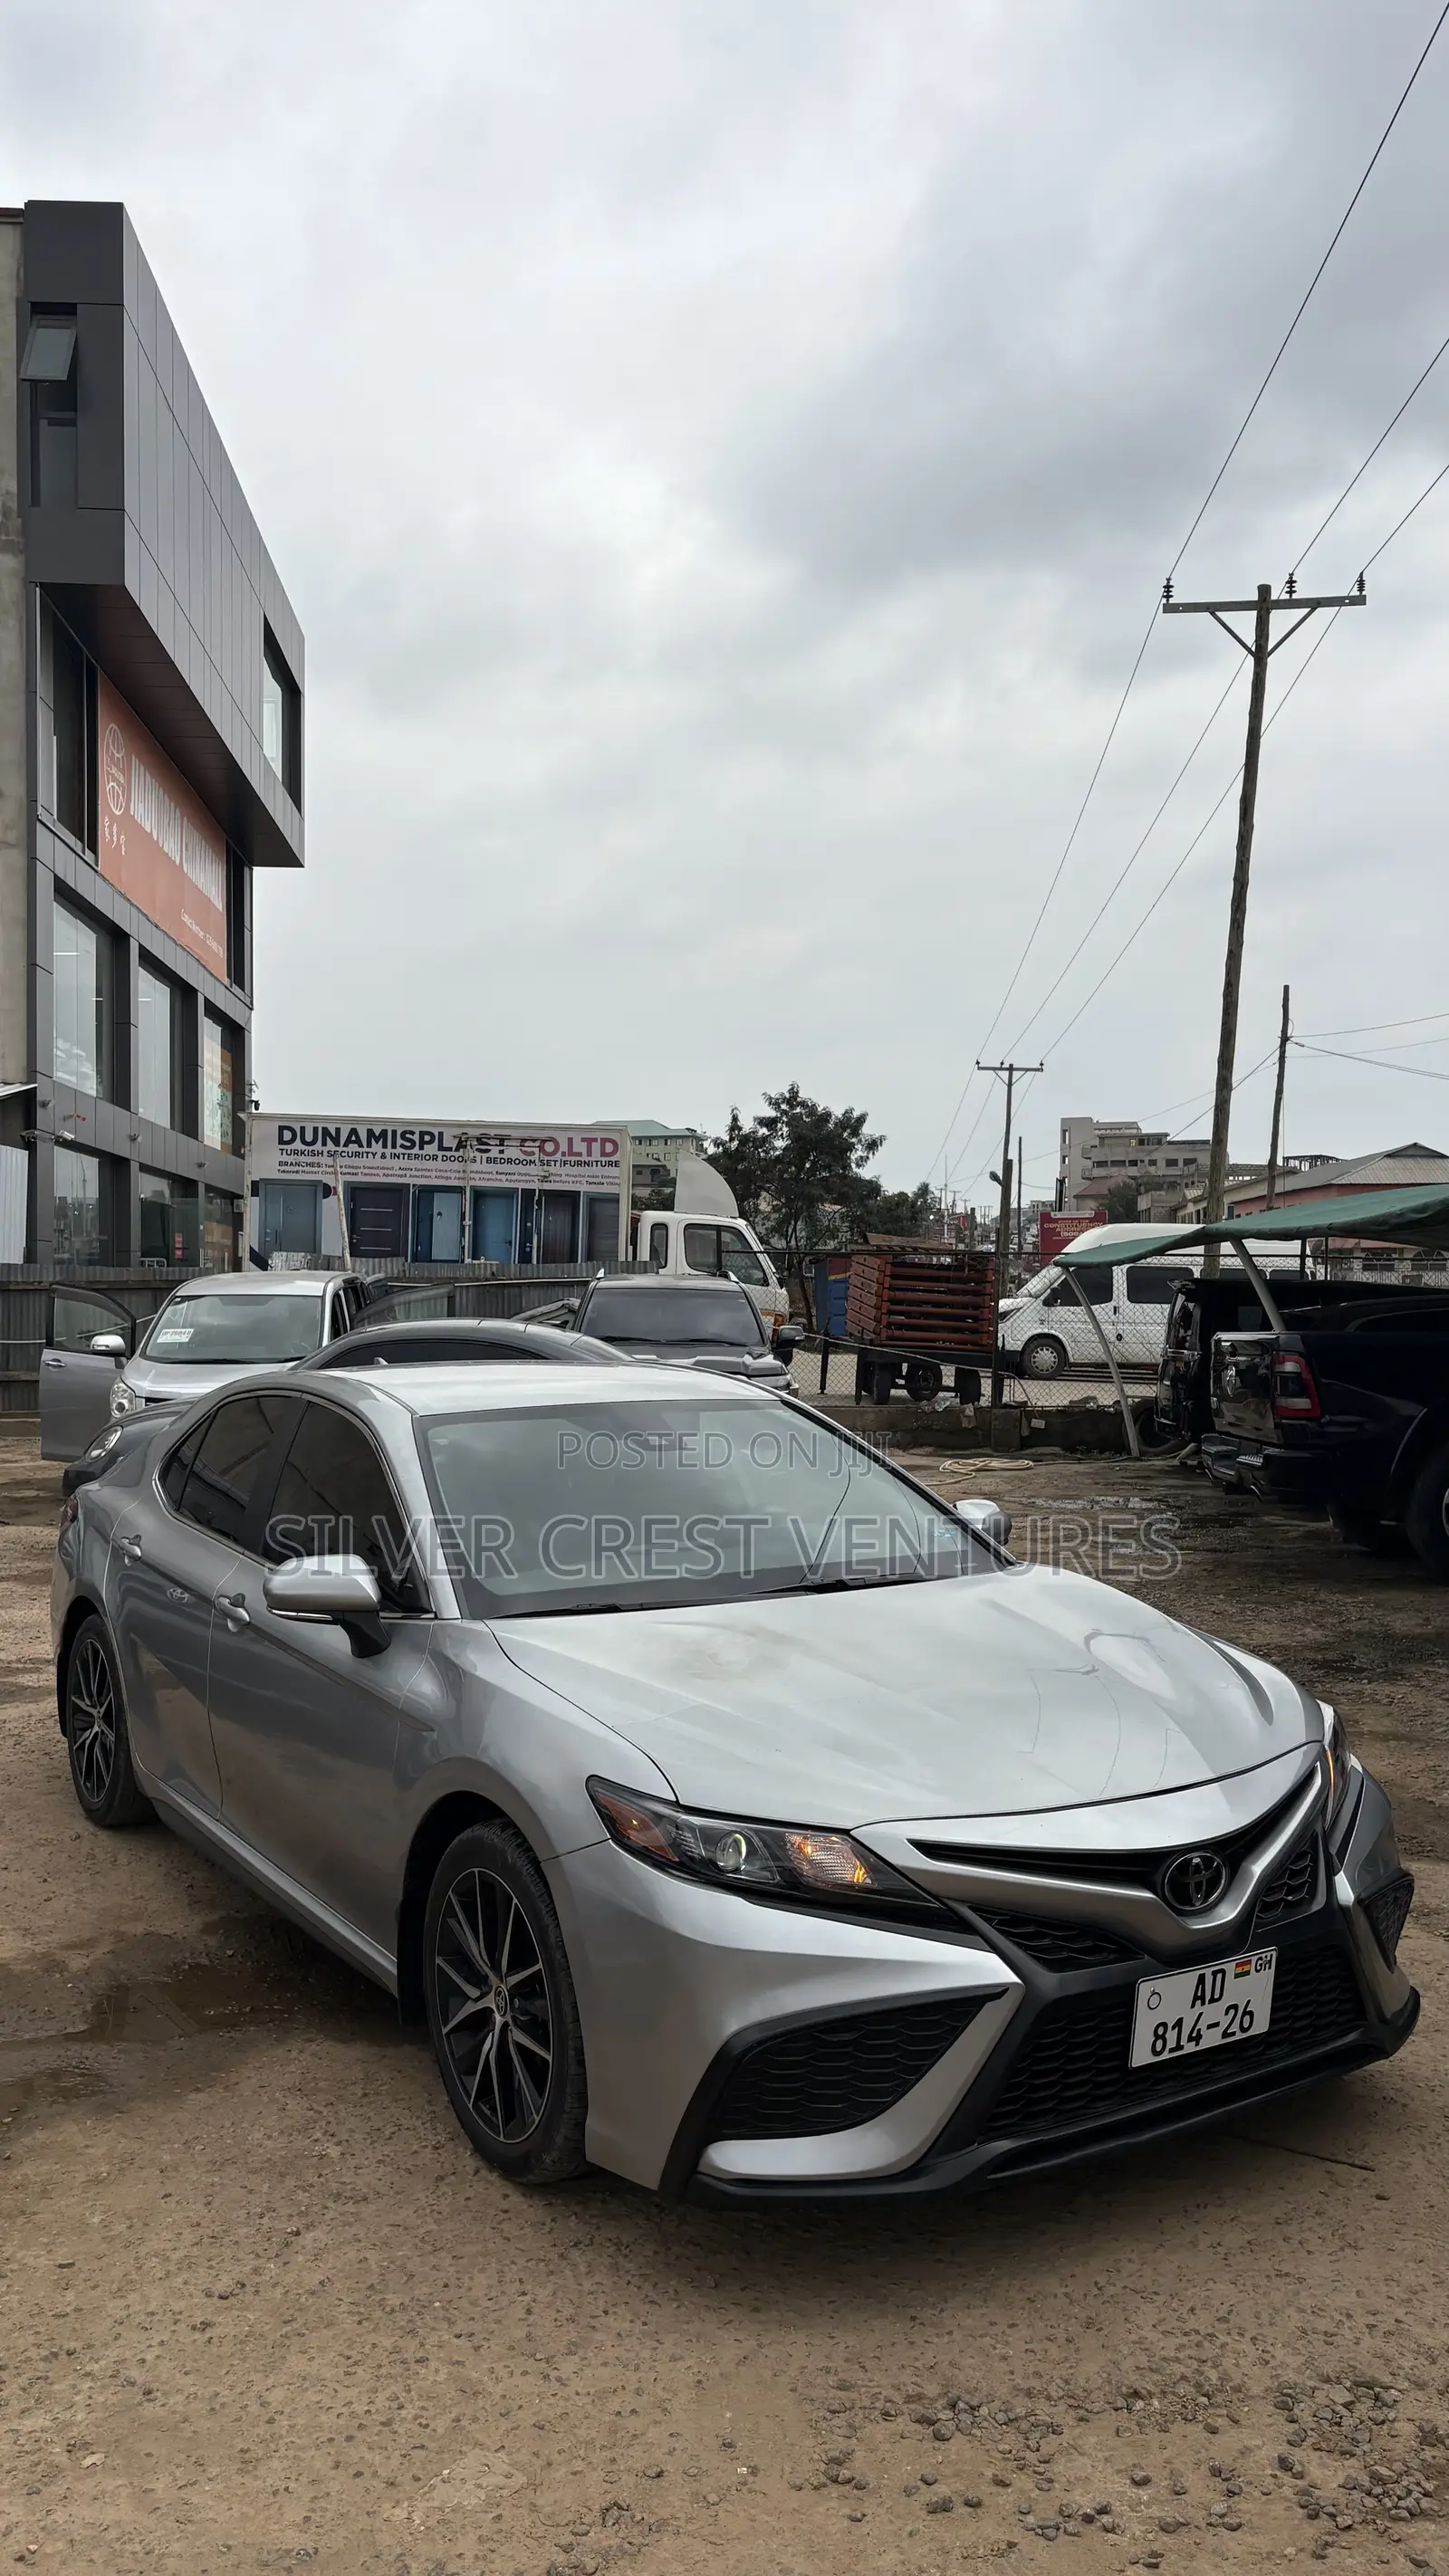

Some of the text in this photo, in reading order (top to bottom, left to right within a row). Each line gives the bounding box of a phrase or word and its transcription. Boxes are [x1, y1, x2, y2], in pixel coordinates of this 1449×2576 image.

[277, 1125, 619, 1158] DUNAMISPLAST CO.LTD
[279, 1148, 324, 1158] TURKISH
[326, 1150, 378, 1160] SECURITY
[379, 1152, 388, 1160] &
[389, 1153, 439, 1163] INTERIOR
[441, 1154, 477, 1164] DOOS
[485, 1156, 537, 1166] BEDROOM
[278, 1160, 323, 1169] BRANCHES:
[1190, 1953, 1273, 2010] AD GH
[1150, 1998, 1255, 2058] 814-26
